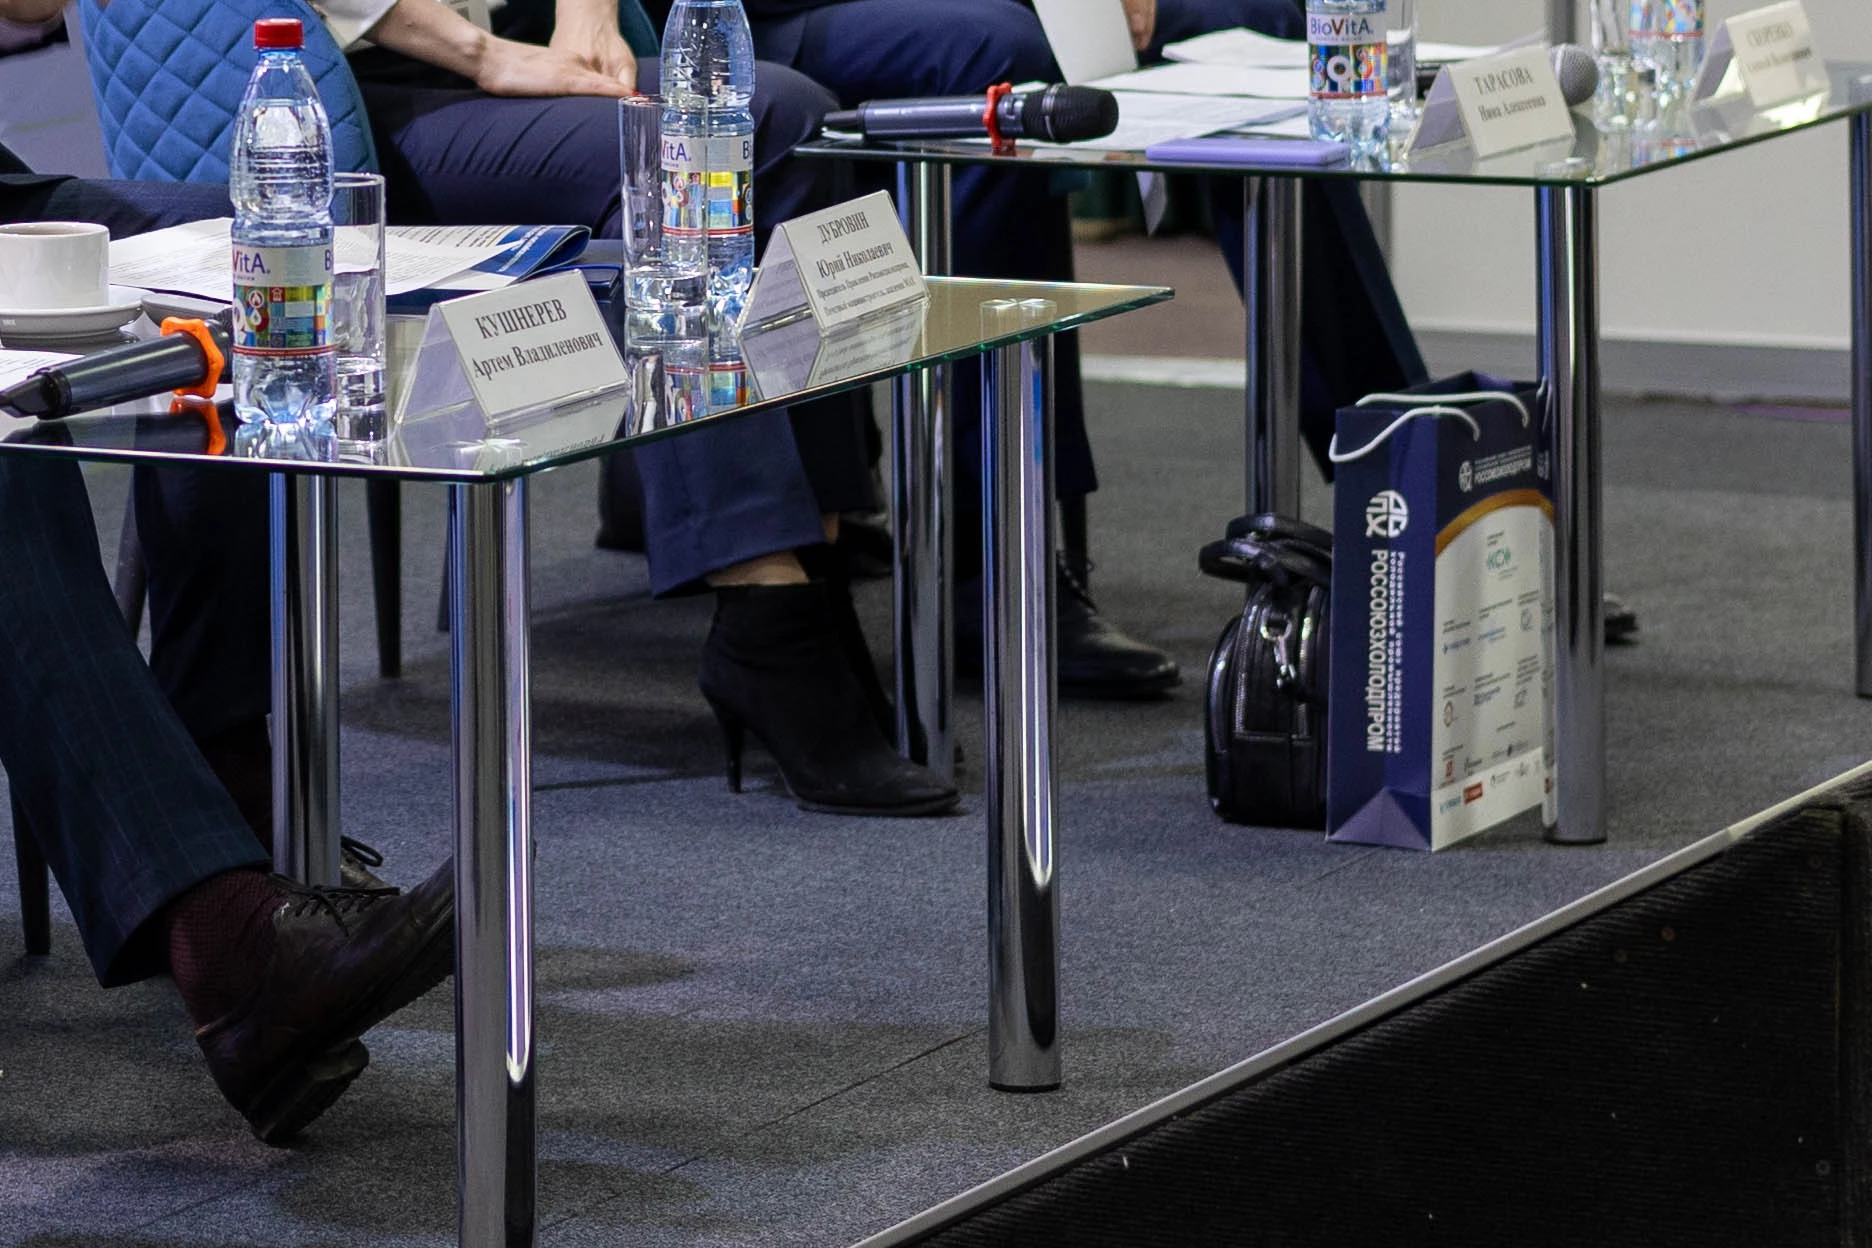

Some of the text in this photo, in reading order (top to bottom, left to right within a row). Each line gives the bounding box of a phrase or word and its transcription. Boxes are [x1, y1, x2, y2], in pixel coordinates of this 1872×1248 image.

[816, 211, 870, 245] ДУБРОВИН
[816, 241, 895, 280] Юрий Николаевич
[474, 298, 567, 340] КУШНЕРЕВ
[471, 332, 604, 381] Артем Владиленович
[1365, 549, 1389, 752] РОССОЮЗХОЛОДПРОМ
